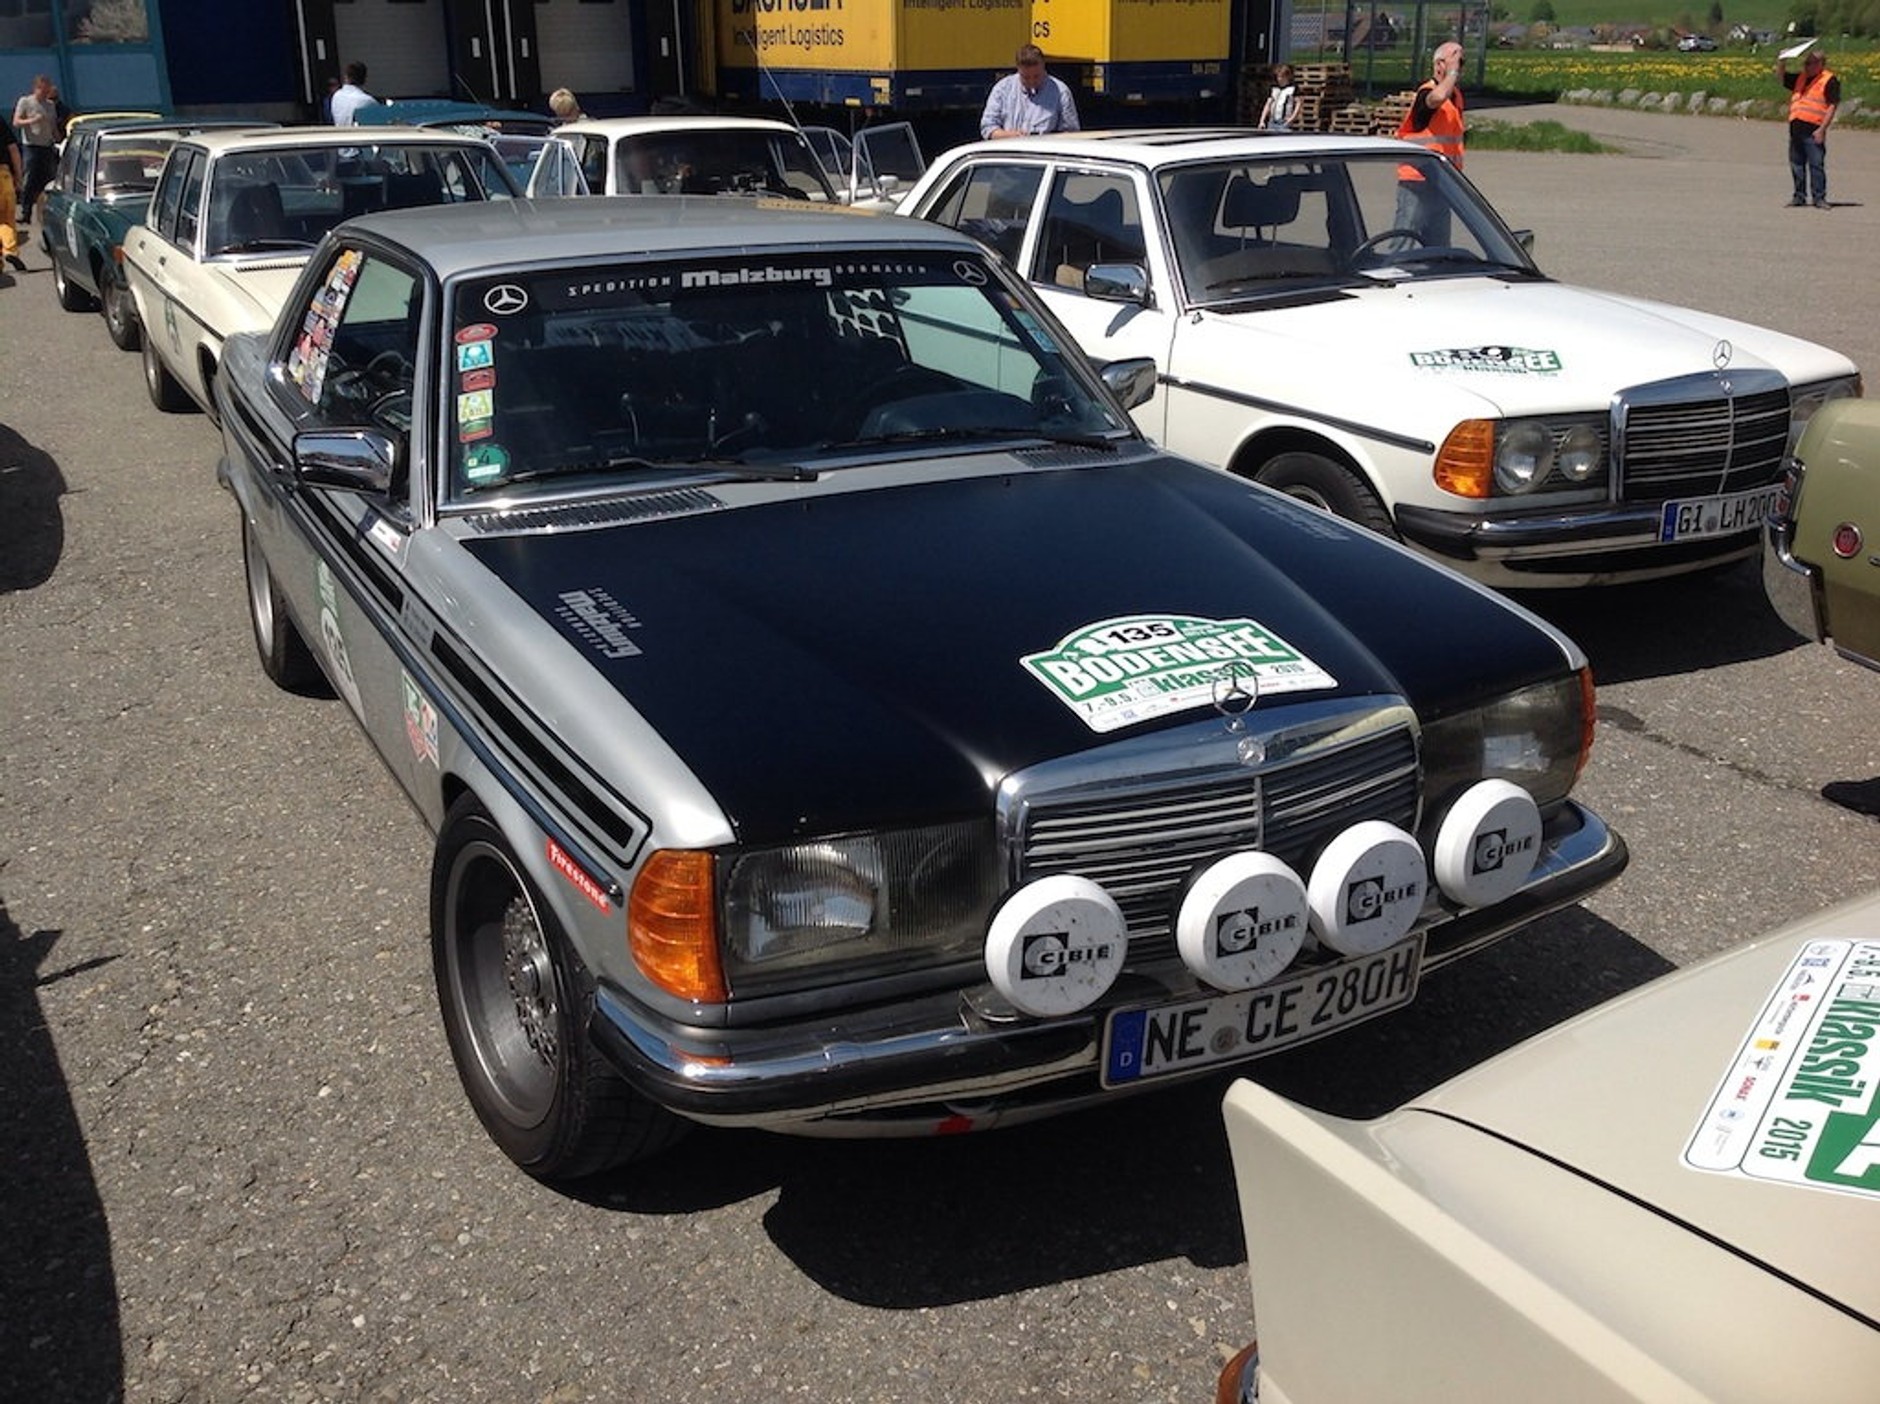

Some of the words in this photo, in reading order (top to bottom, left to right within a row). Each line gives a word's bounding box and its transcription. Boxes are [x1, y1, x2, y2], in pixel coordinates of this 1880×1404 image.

[789, 24, 844, 51] Logistics
[567, 276, 672, 297] SPEDITION
[681, 267, 832, 288] Malzburg
[1678, 506, 1703, 533] GI
[1108, 622, 1176, 644] 135
[1039, 626, 1291, 697] BODENSEE
[1120, 1052, 1132, 1068] D
[1145, 1008, 1208, 1066] NE
[1245, 986, 1303, 1043] CE
[1311, 949, 1414, 1026] 280H
[1759, 1117, 1812, 1161] 2015
